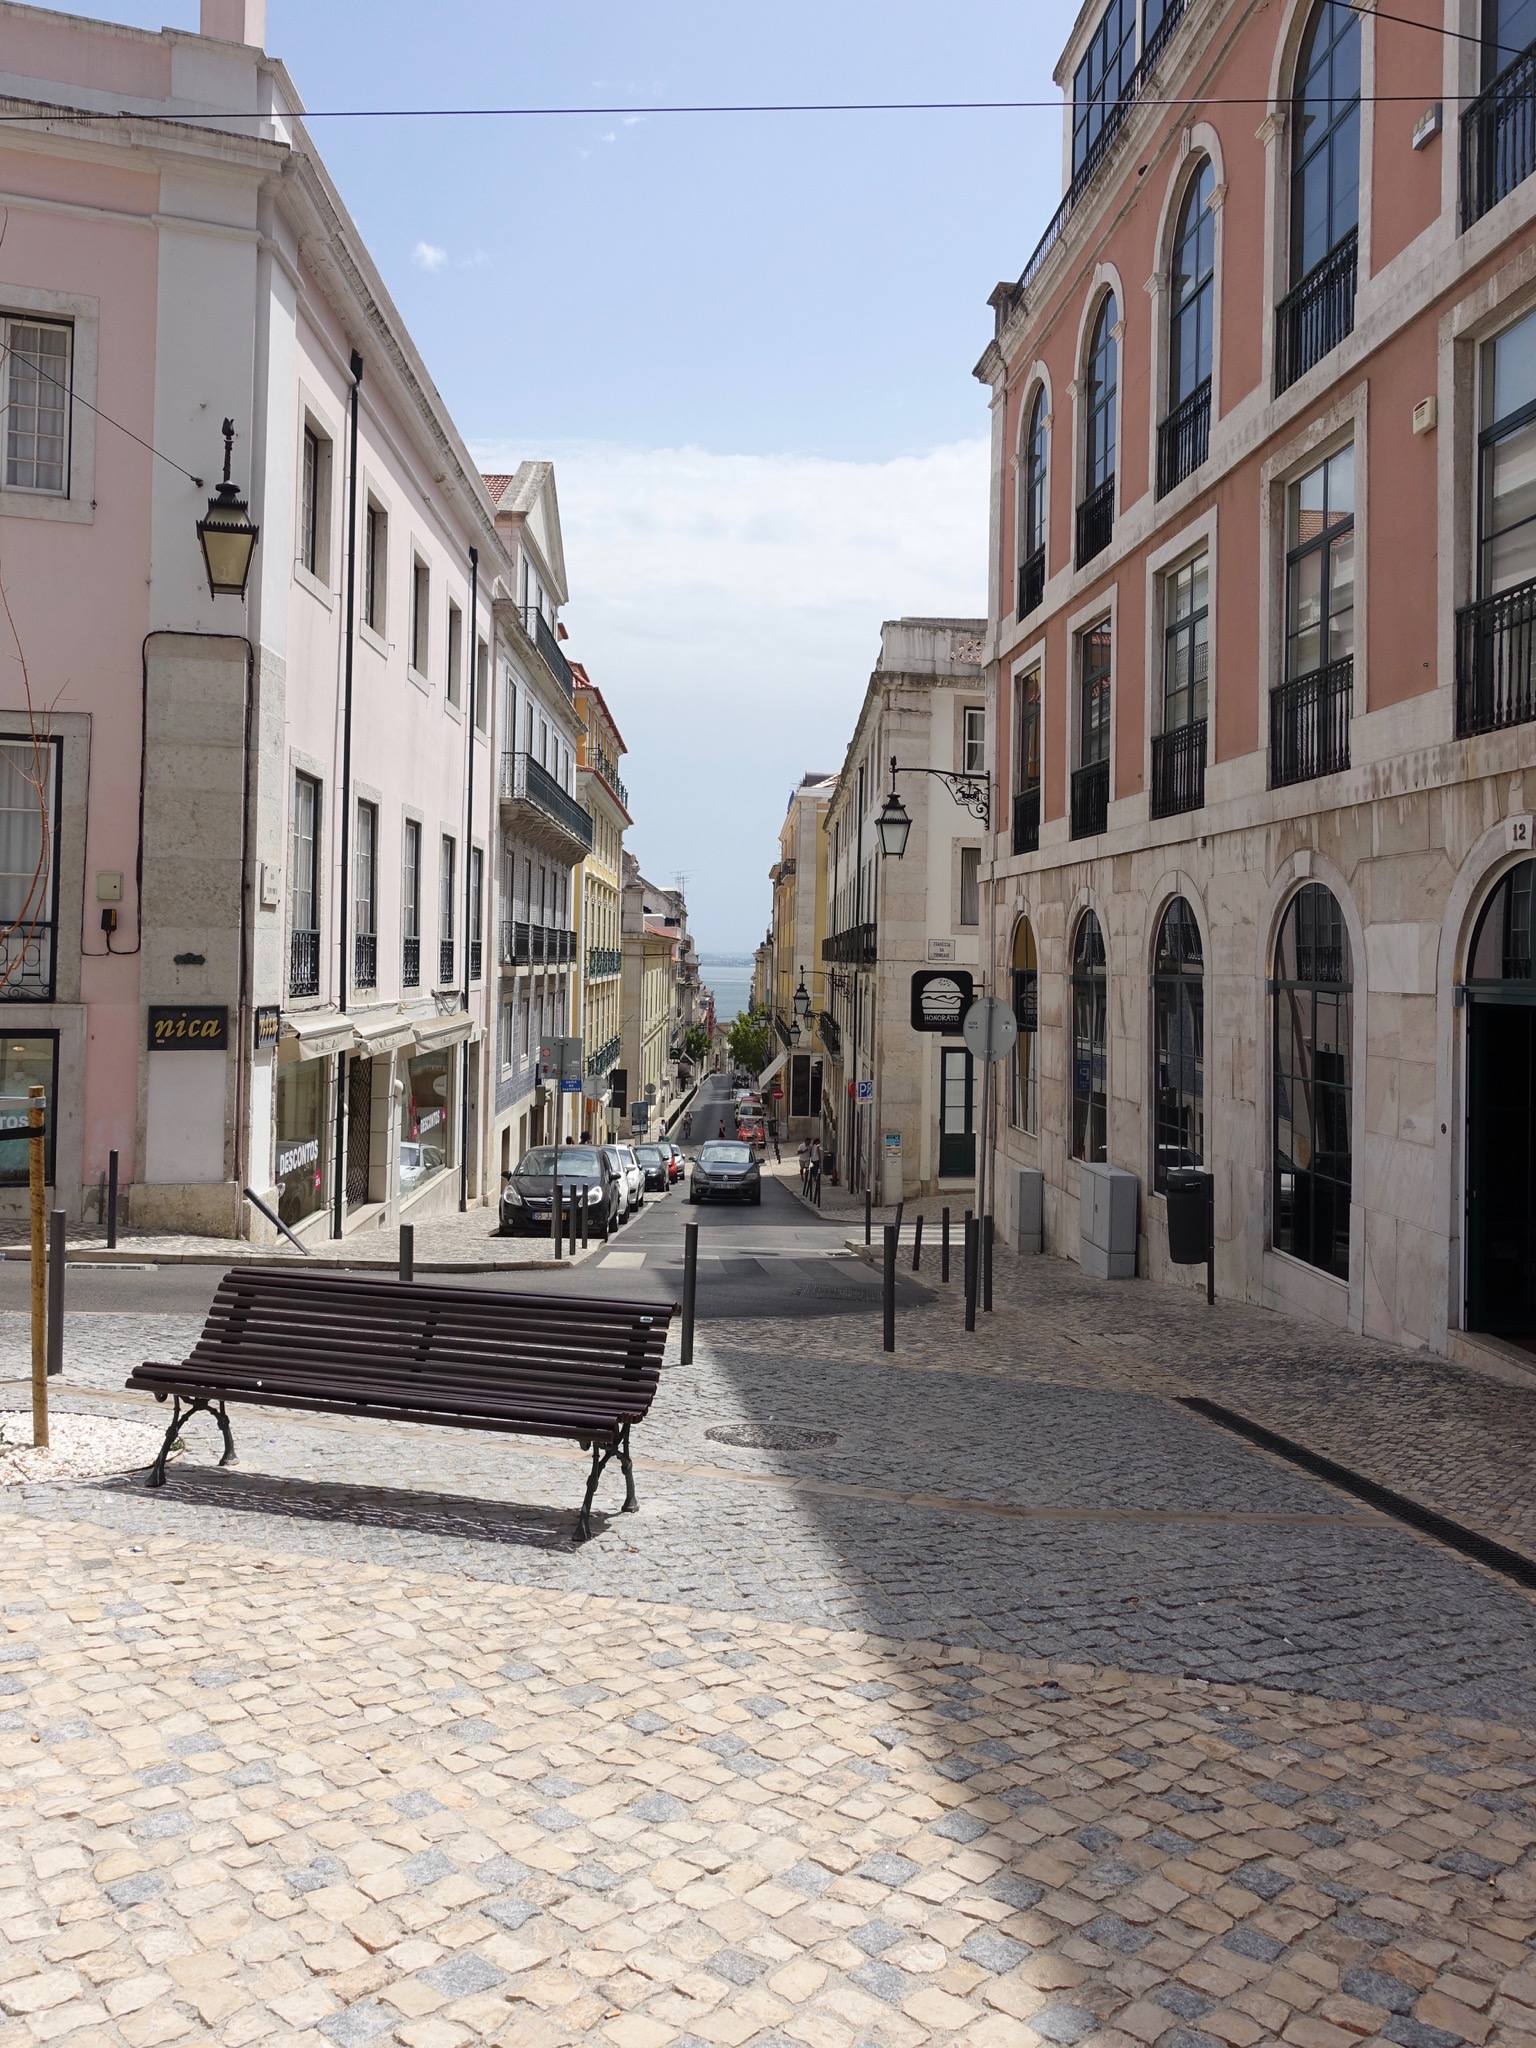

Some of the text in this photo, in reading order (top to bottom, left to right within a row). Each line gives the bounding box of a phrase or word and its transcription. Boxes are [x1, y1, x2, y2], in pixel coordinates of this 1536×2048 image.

[1513, 823, 1526, 841] 12
[155, 1012, 222, 1038] nica
[280, 1139, 318, 1176] DESCONTOS
